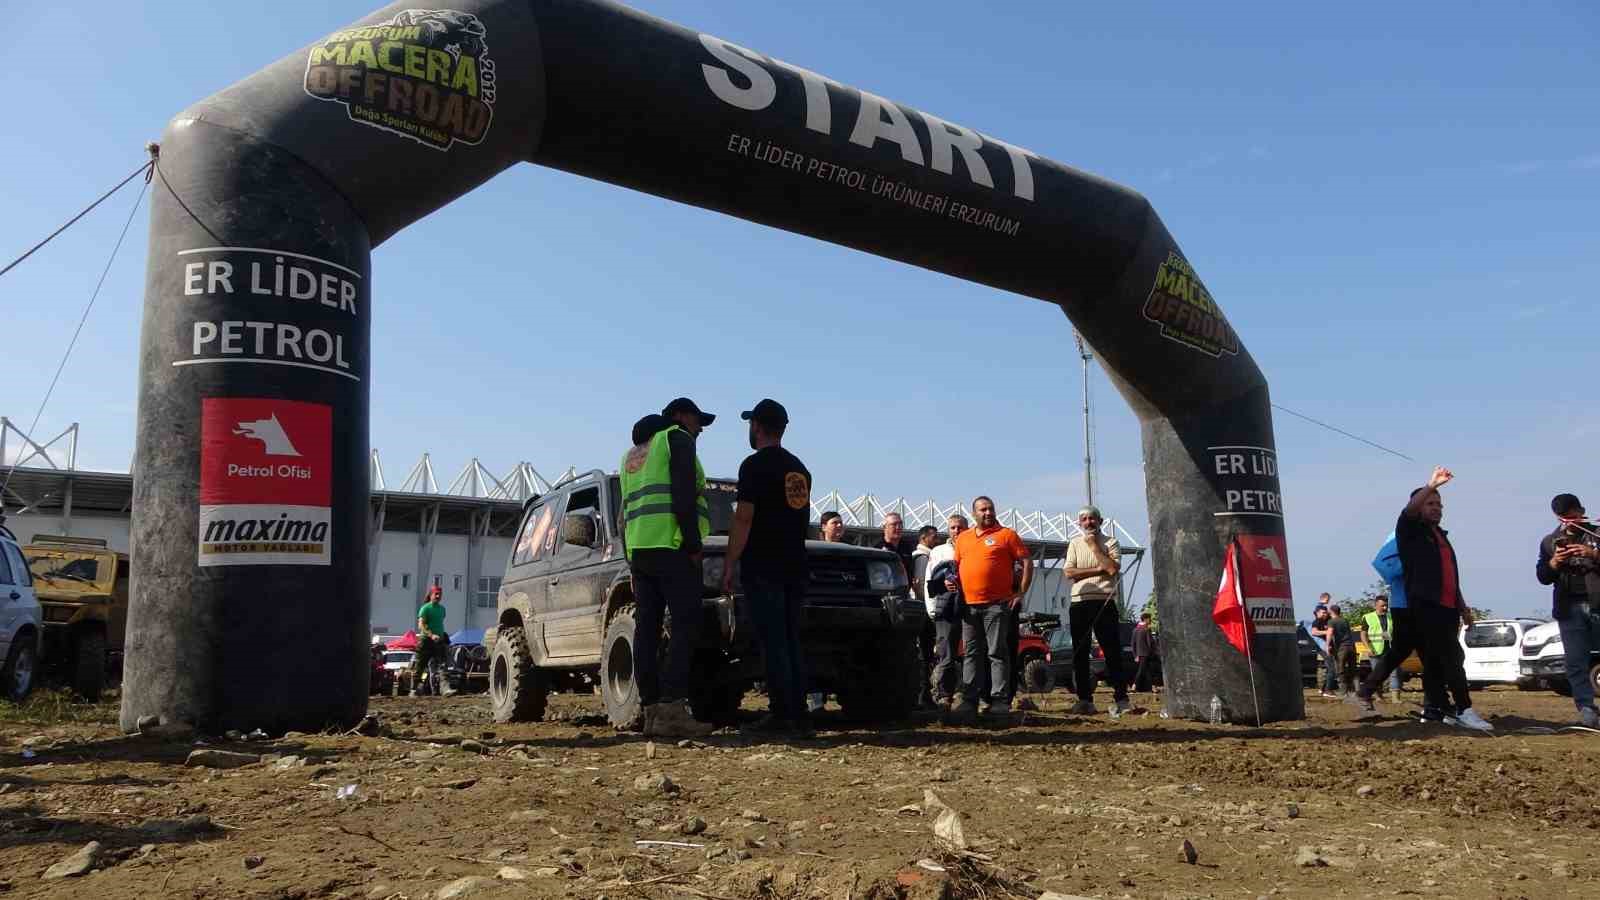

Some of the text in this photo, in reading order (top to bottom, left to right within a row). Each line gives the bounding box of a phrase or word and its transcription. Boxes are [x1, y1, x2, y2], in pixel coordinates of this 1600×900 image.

[311, 40, 477, 97] MACERA
[481, 59, 495, 103] 2012
[307, 66, 488, 140] OFFROAD
[698, 33, 1041, 201] START
[727, 133, 1021, 237] ER LİDER PETROL ÜRÜNLERİ ERZURUM
[184, 256, 357, 316] ER LİDER
[193, 320, 350, 369] PETROL
[228, 463, 312, 480] Petrol Ofisi
[1215, 450, 1278, 477] ER LİD
[1226, 490, 1282, 512] PETRO
[204, 512, 328, 542] maxima
